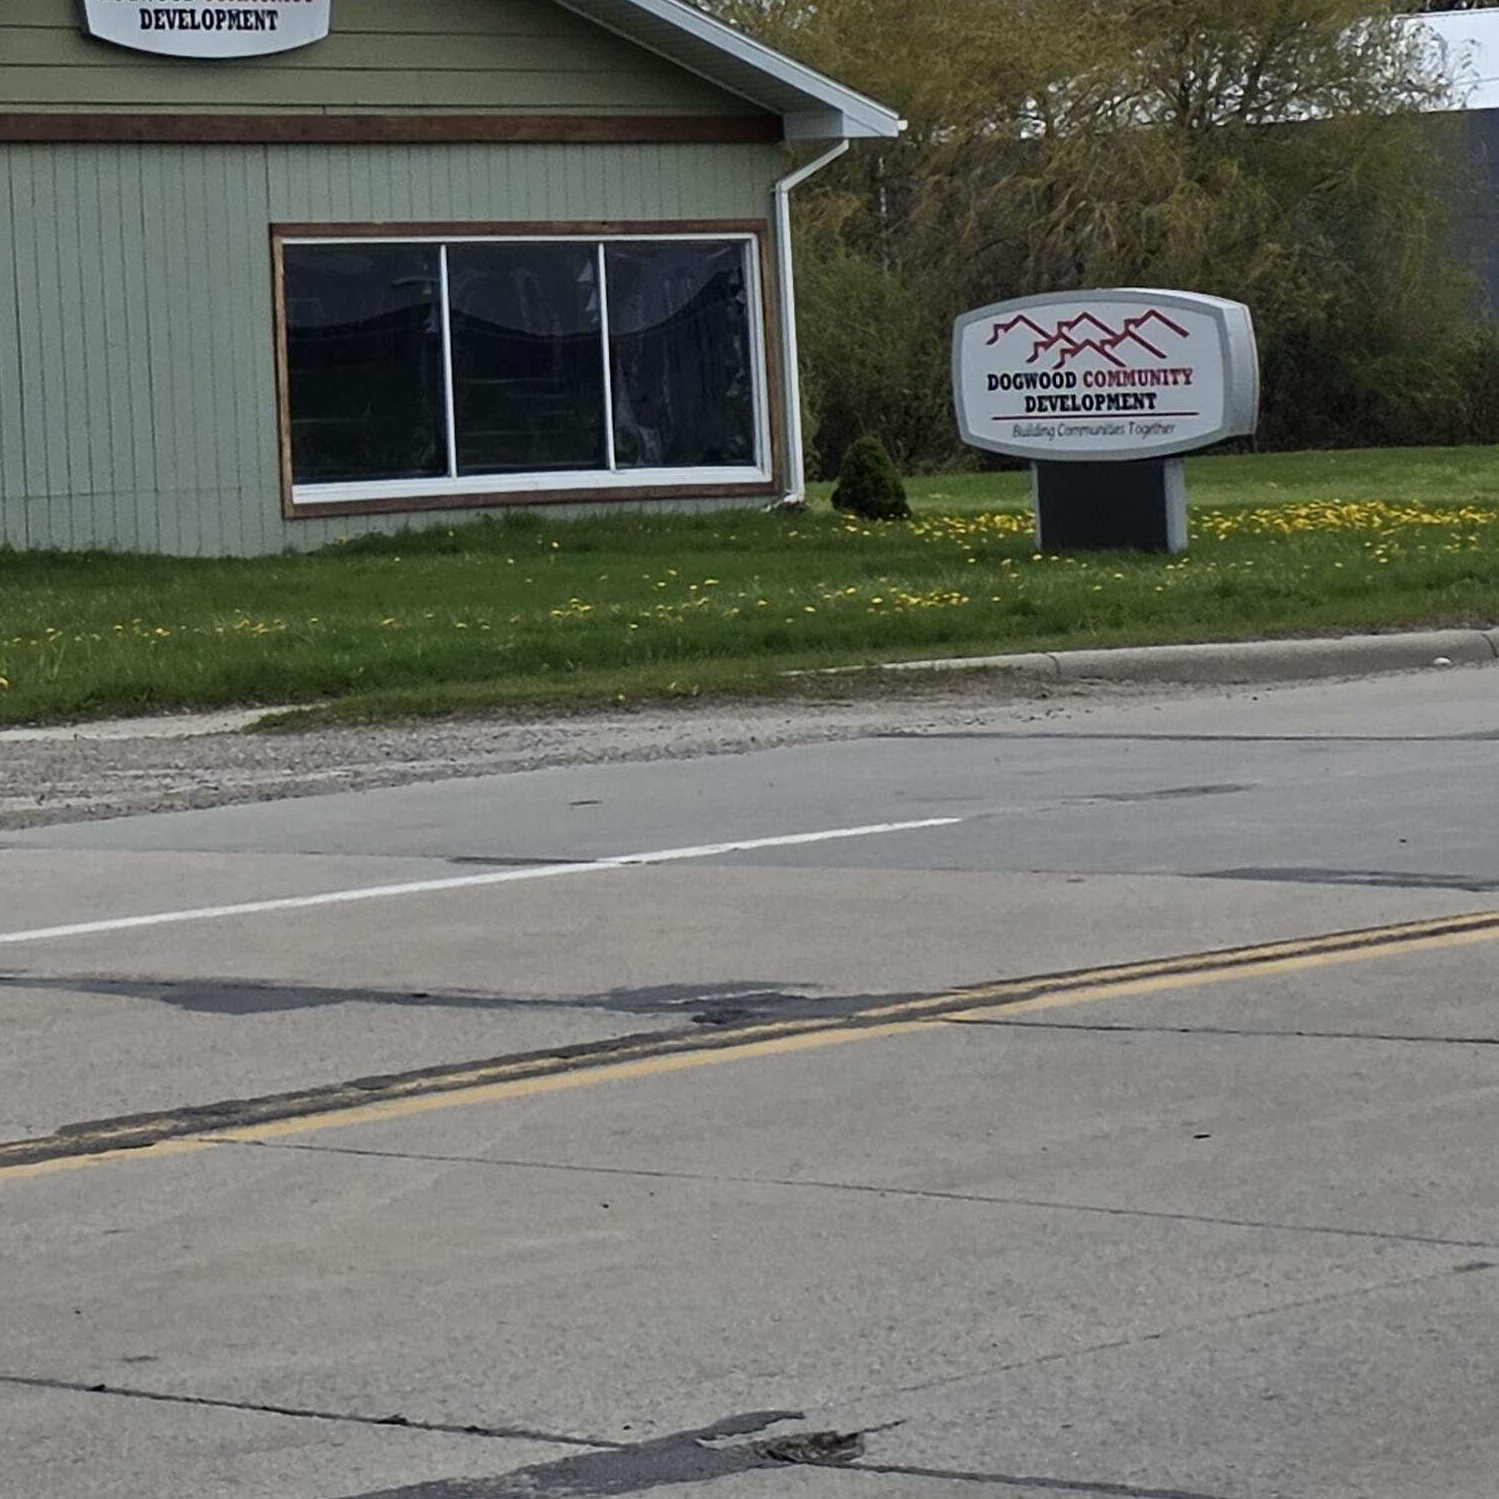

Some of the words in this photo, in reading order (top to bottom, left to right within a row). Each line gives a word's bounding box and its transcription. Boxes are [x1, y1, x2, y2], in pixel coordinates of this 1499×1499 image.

[140, 9, 278, 31] DEVELOPMENT
[987, 371, 1077, 391] DOGWOOD
[1083, 368, 1193, 388] COMMUNITY
[1025, 393, 1157, 413] DEVELOPMENT
[1012, 423, 1055, 440] Building
[1057, 422, 1125, 437] Communities
[1128, 421, 1176, 439] Together
